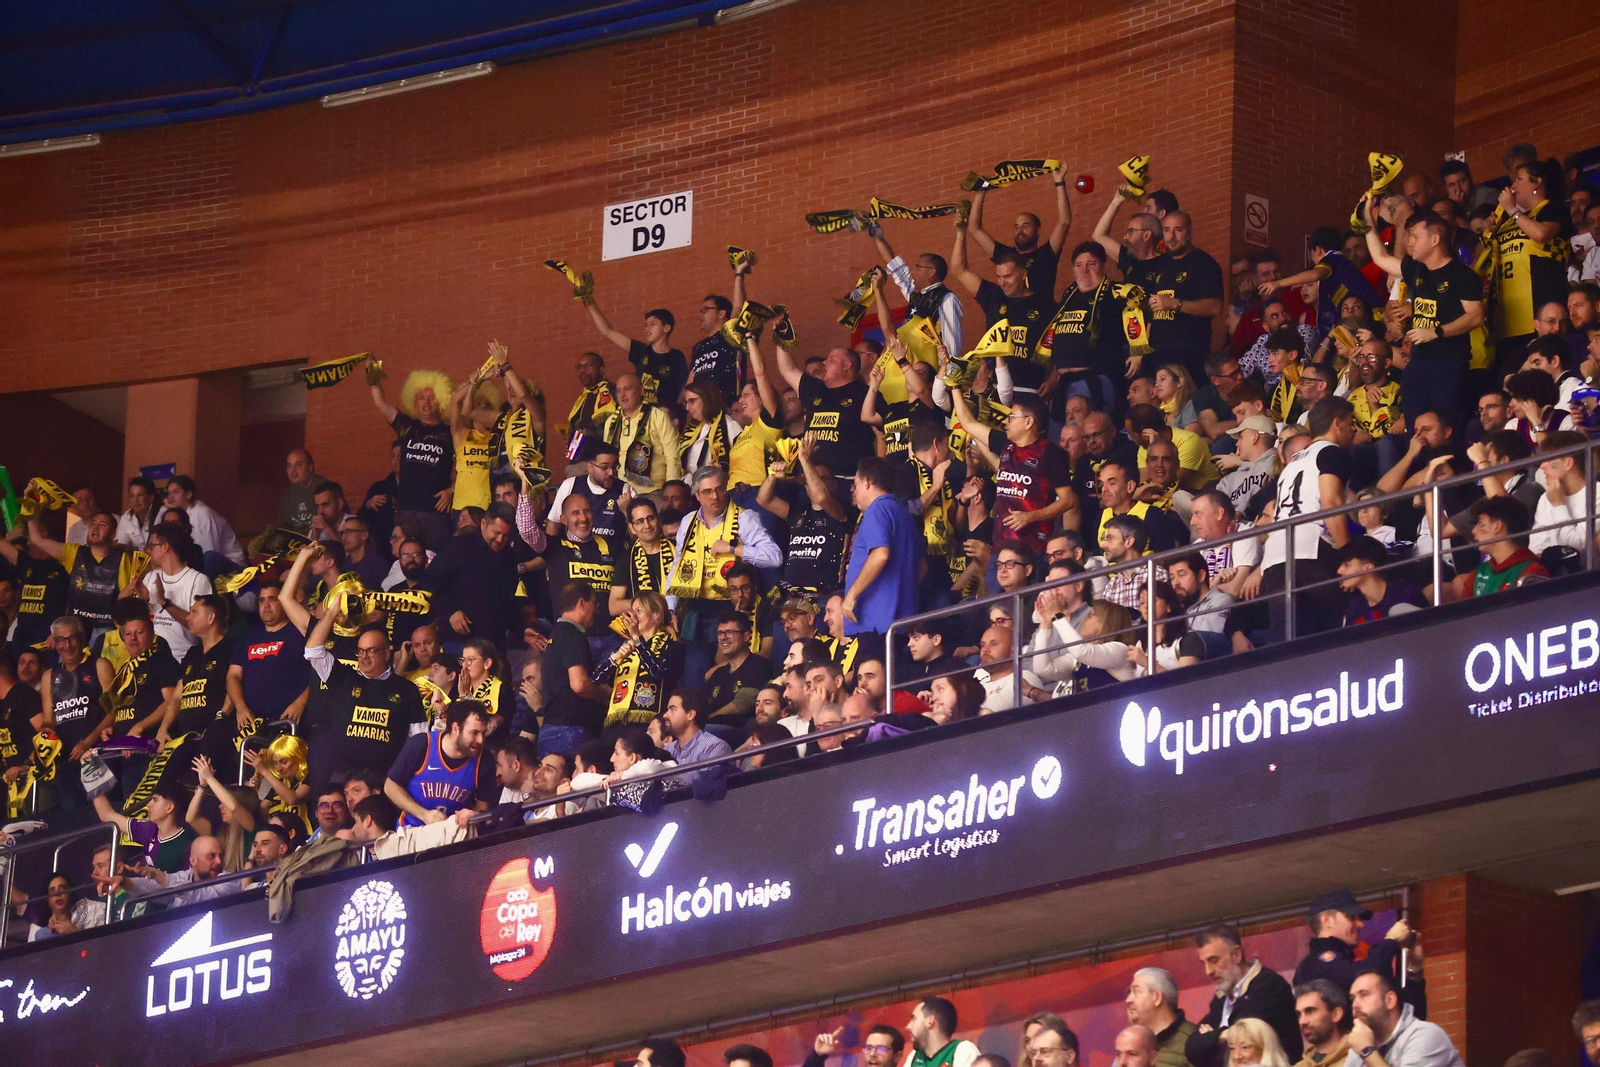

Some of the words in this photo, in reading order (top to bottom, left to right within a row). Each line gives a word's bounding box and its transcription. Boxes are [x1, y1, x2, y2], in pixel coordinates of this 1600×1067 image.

[610, 196, 687, 226] SECTOR
[633, 224, 665, 252] D9
[406, 439, 444, 455] Lenovo
[997, 469, 1032, 486] Lenovo
[592, 527, 615, 536] HERO
[356, 709, 387, 724] VAMOS
[1159, 658, 1404, 775] quirónsalud
[1468, 696, 1513, 718] Ticket
[346, 724, 391, 743] CANARIAS
[852, 773, 1026, 850] Transaher
[883, 840, 932, 868] Smart
[934, 829, 1001, 858] Logistics
[497, 902, 539, 923] Copa
[621, 876, 733, 934] Halcón
[736, 879, 792, 909] viajes
[336, 923, 406, 960] AMAYU
[516, 921, 542, 943] Rey
[145, 949, 273, 1018] LOTUS
